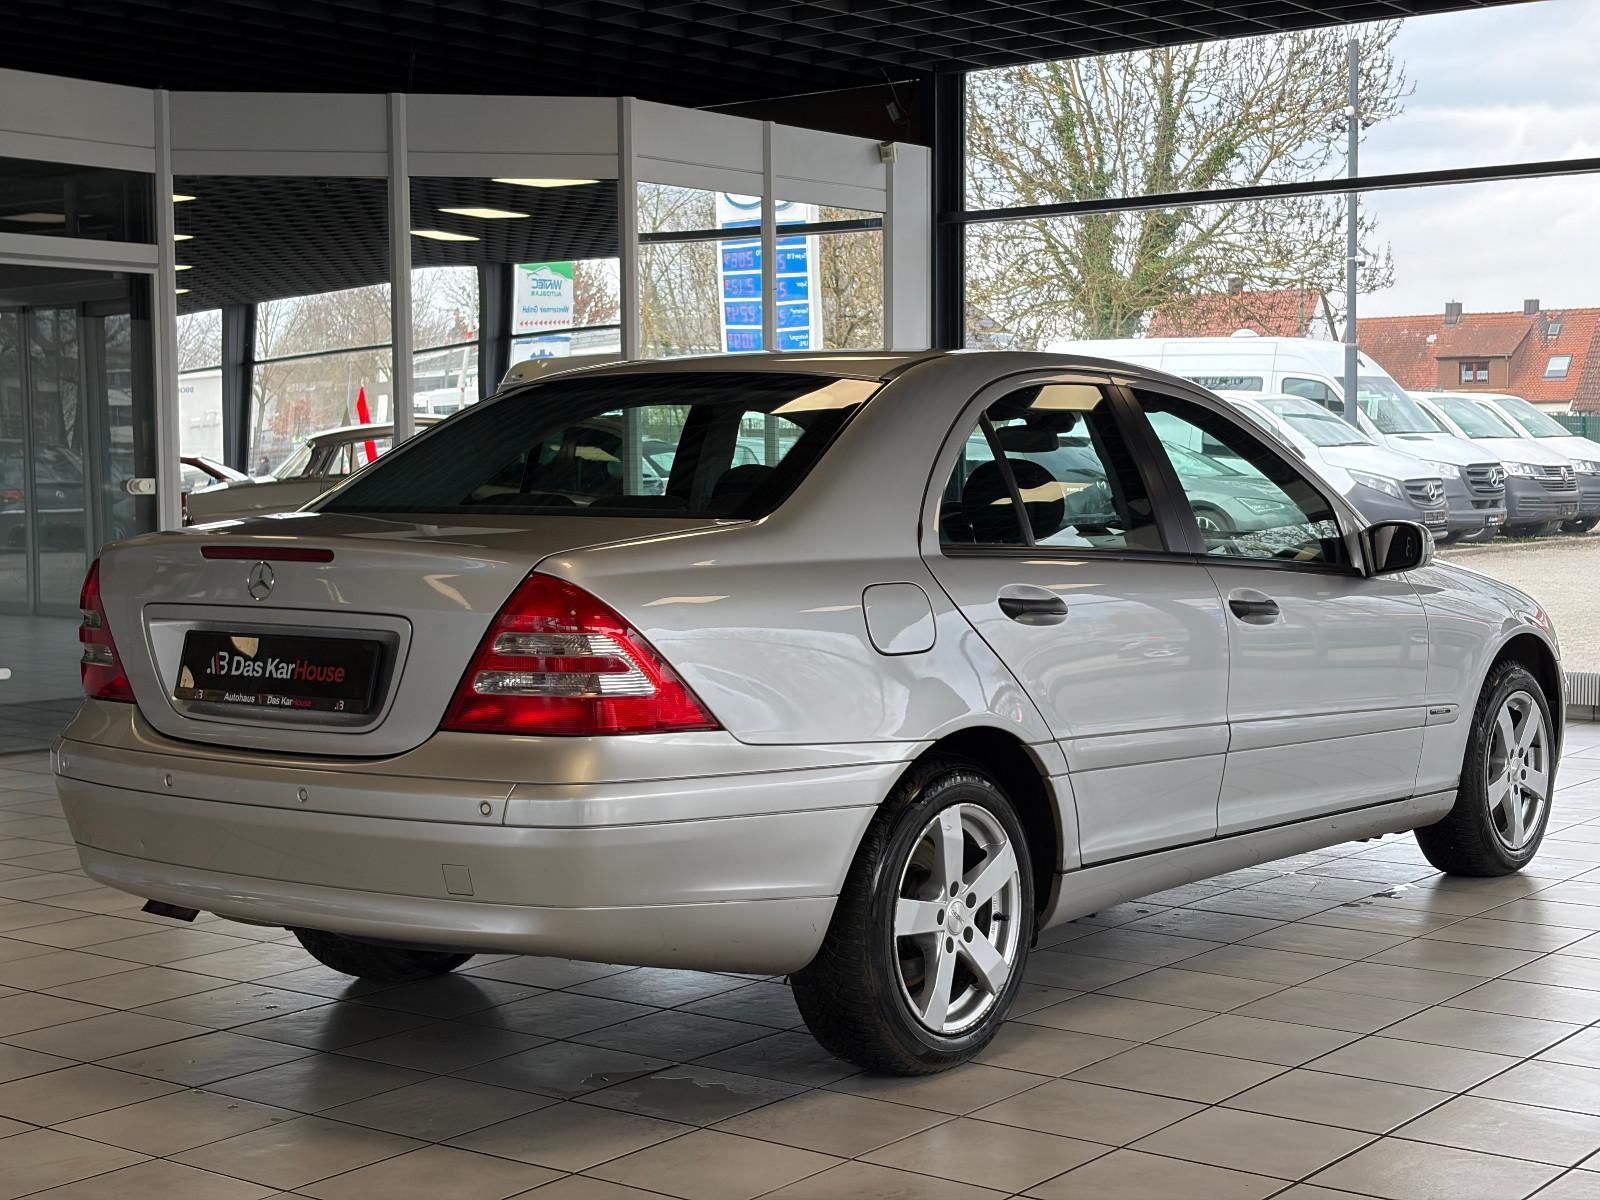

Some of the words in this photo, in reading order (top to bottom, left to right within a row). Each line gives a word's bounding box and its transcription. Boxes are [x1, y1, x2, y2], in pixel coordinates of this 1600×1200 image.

[230, 655, 263, 678] Das
[265, 657, 346, 683] KarHouse
[223, 691, 256, 704] Autohaus
[267, 695, 281, 705] Das
